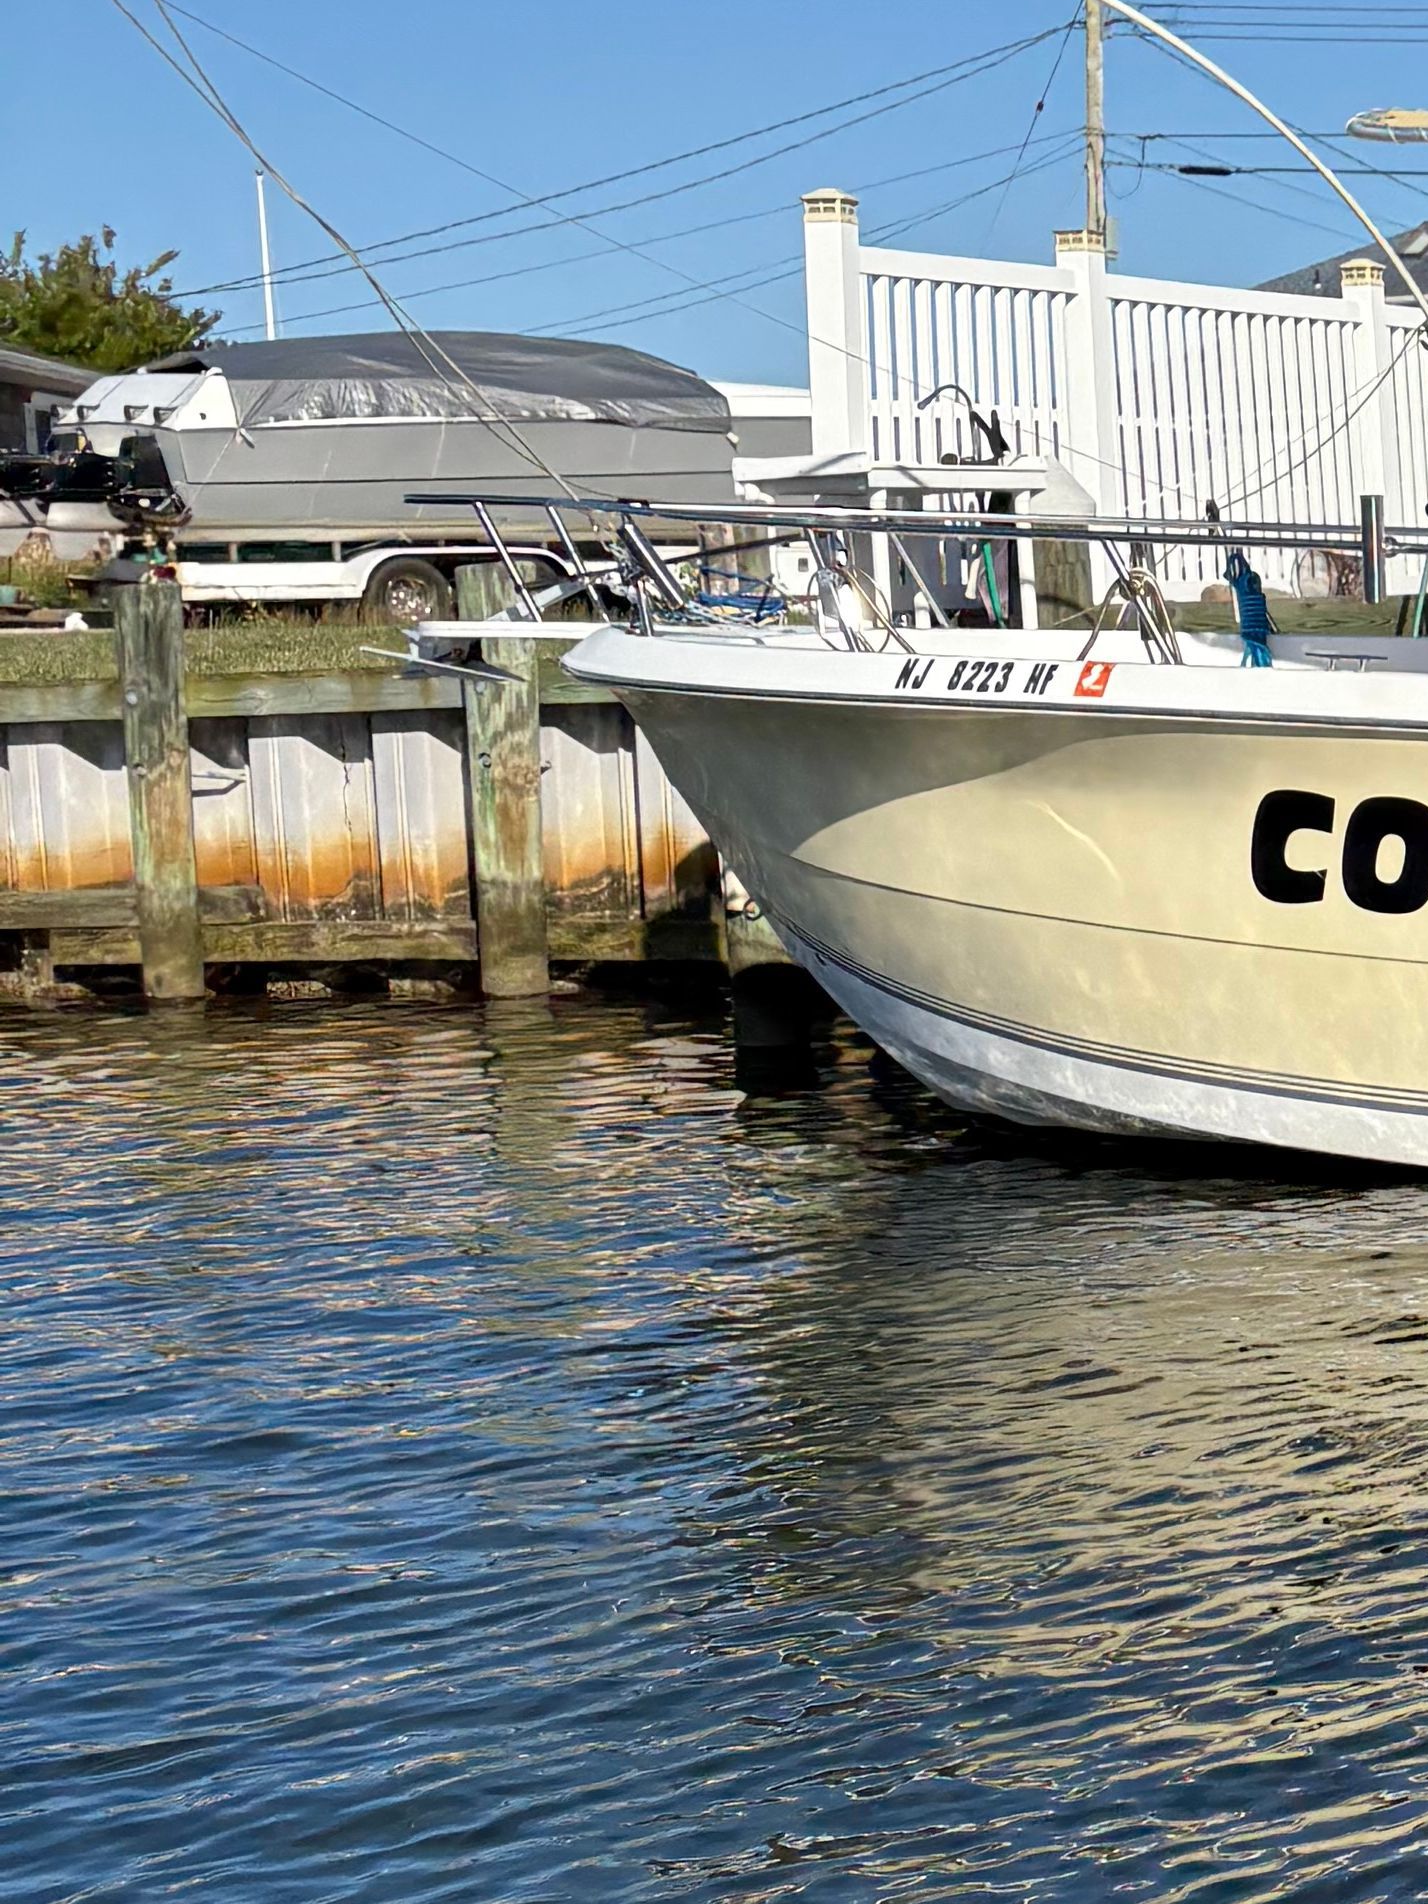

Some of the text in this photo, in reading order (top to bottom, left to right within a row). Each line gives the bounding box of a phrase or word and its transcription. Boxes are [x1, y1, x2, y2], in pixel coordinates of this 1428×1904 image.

[894, 658, 1059, 695] NJ 8223 HF
